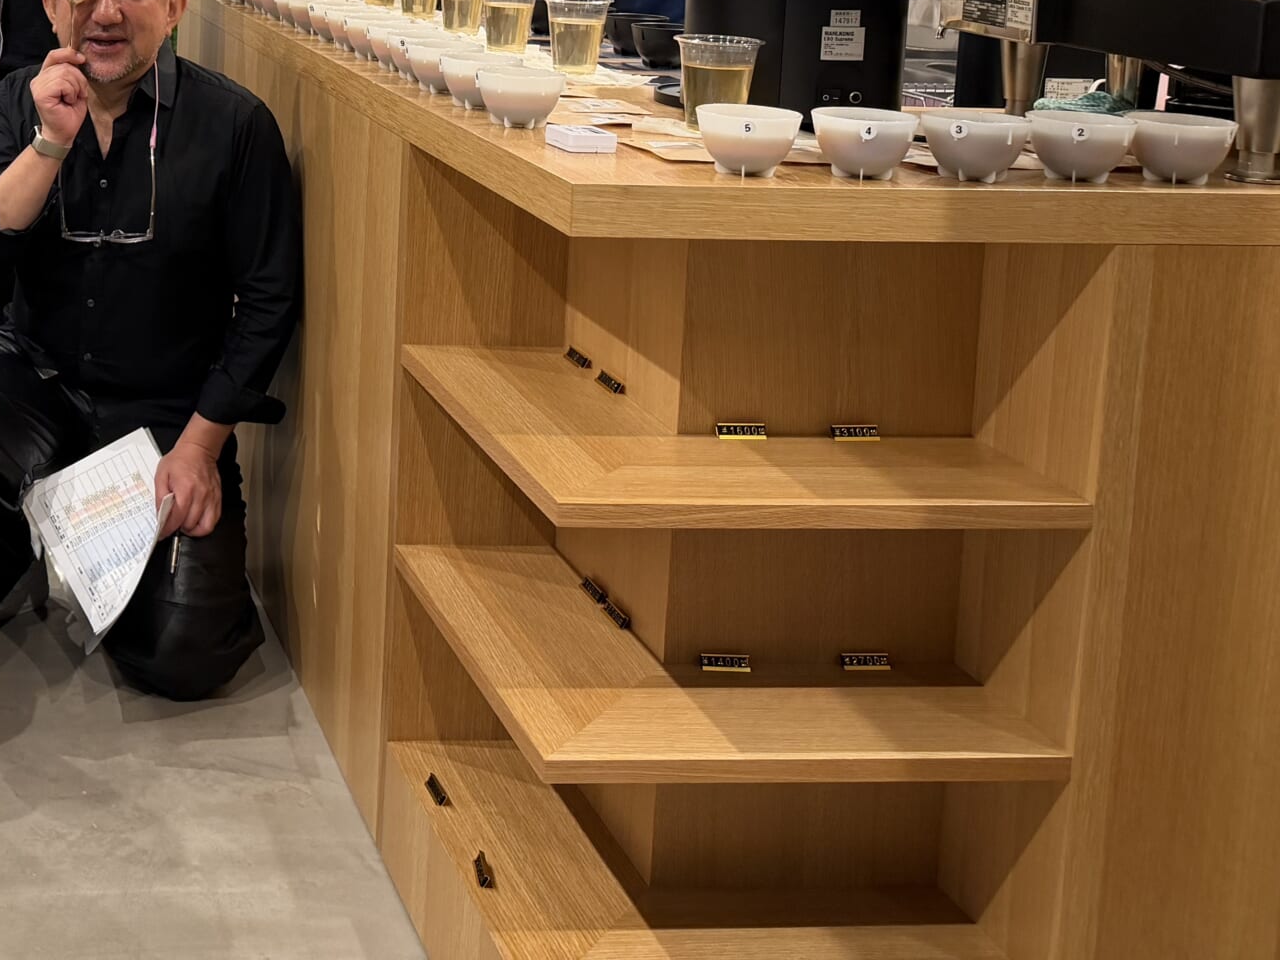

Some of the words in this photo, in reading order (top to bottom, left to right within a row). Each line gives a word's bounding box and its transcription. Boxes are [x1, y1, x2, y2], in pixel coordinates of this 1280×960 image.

[744, 123, 751, 133] 5
[865, 126, 872, 135] 4
[955, 125, 963, 134] 3
[1077, 128, 1085, 137] 2
